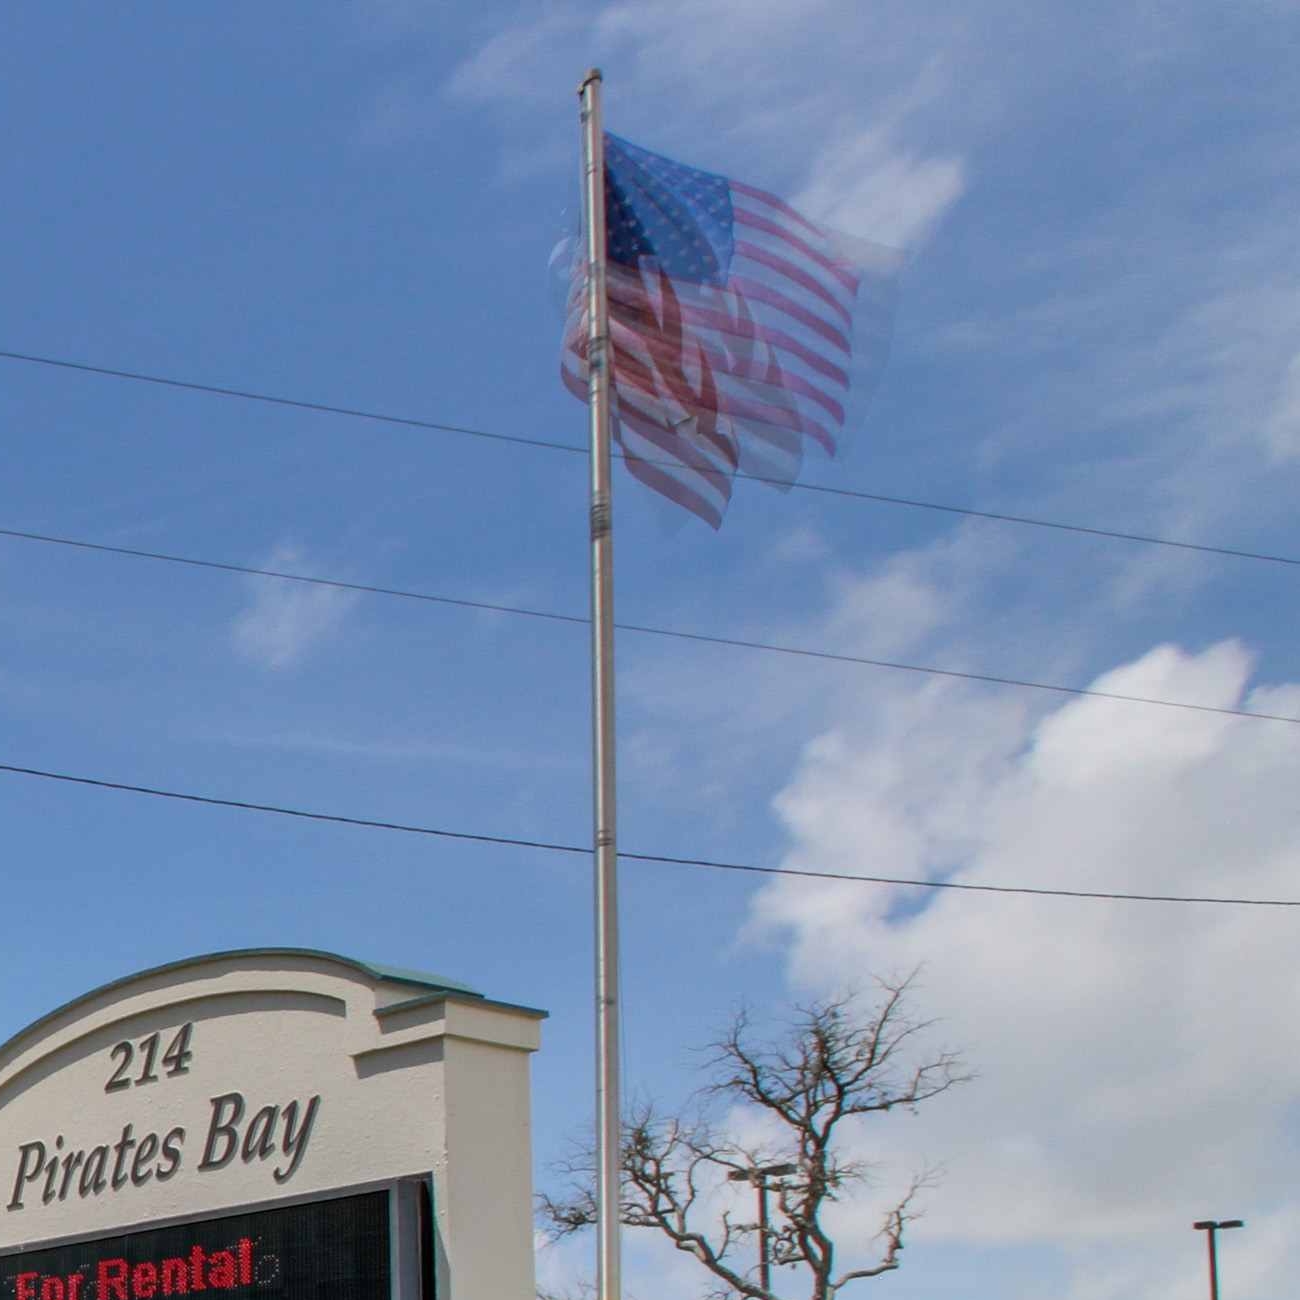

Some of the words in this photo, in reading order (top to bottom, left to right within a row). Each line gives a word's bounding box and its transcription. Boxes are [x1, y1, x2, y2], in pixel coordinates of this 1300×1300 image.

[105, 1021, 193, 1093] 214
[6, 1122, 187, 1212] Pirates
[197, 1091, 322, 1184] Bay
